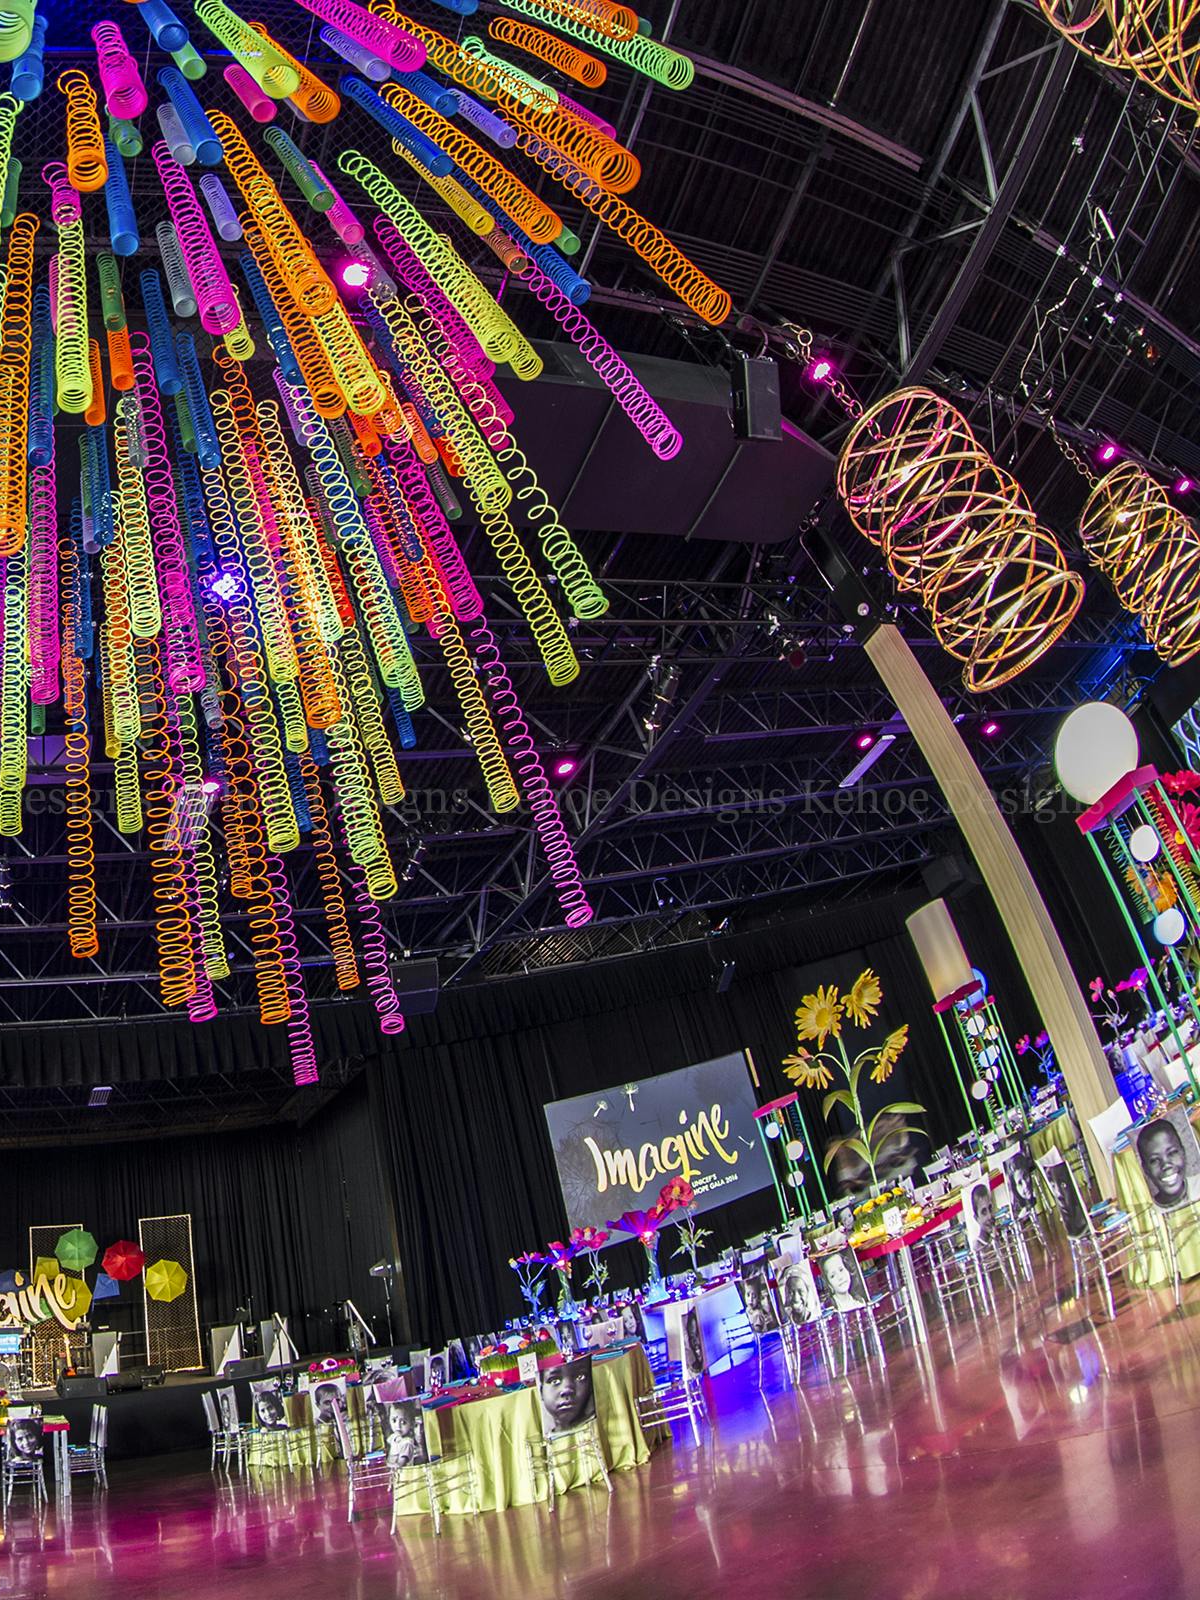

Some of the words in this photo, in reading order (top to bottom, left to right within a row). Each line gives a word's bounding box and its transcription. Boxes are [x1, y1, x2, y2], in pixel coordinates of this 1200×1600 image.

[584, 1103, 739, 1193] Imagine
[693, 1184, 710, 1196] HOPE
[709, 1179, 726, 1190] GALA
